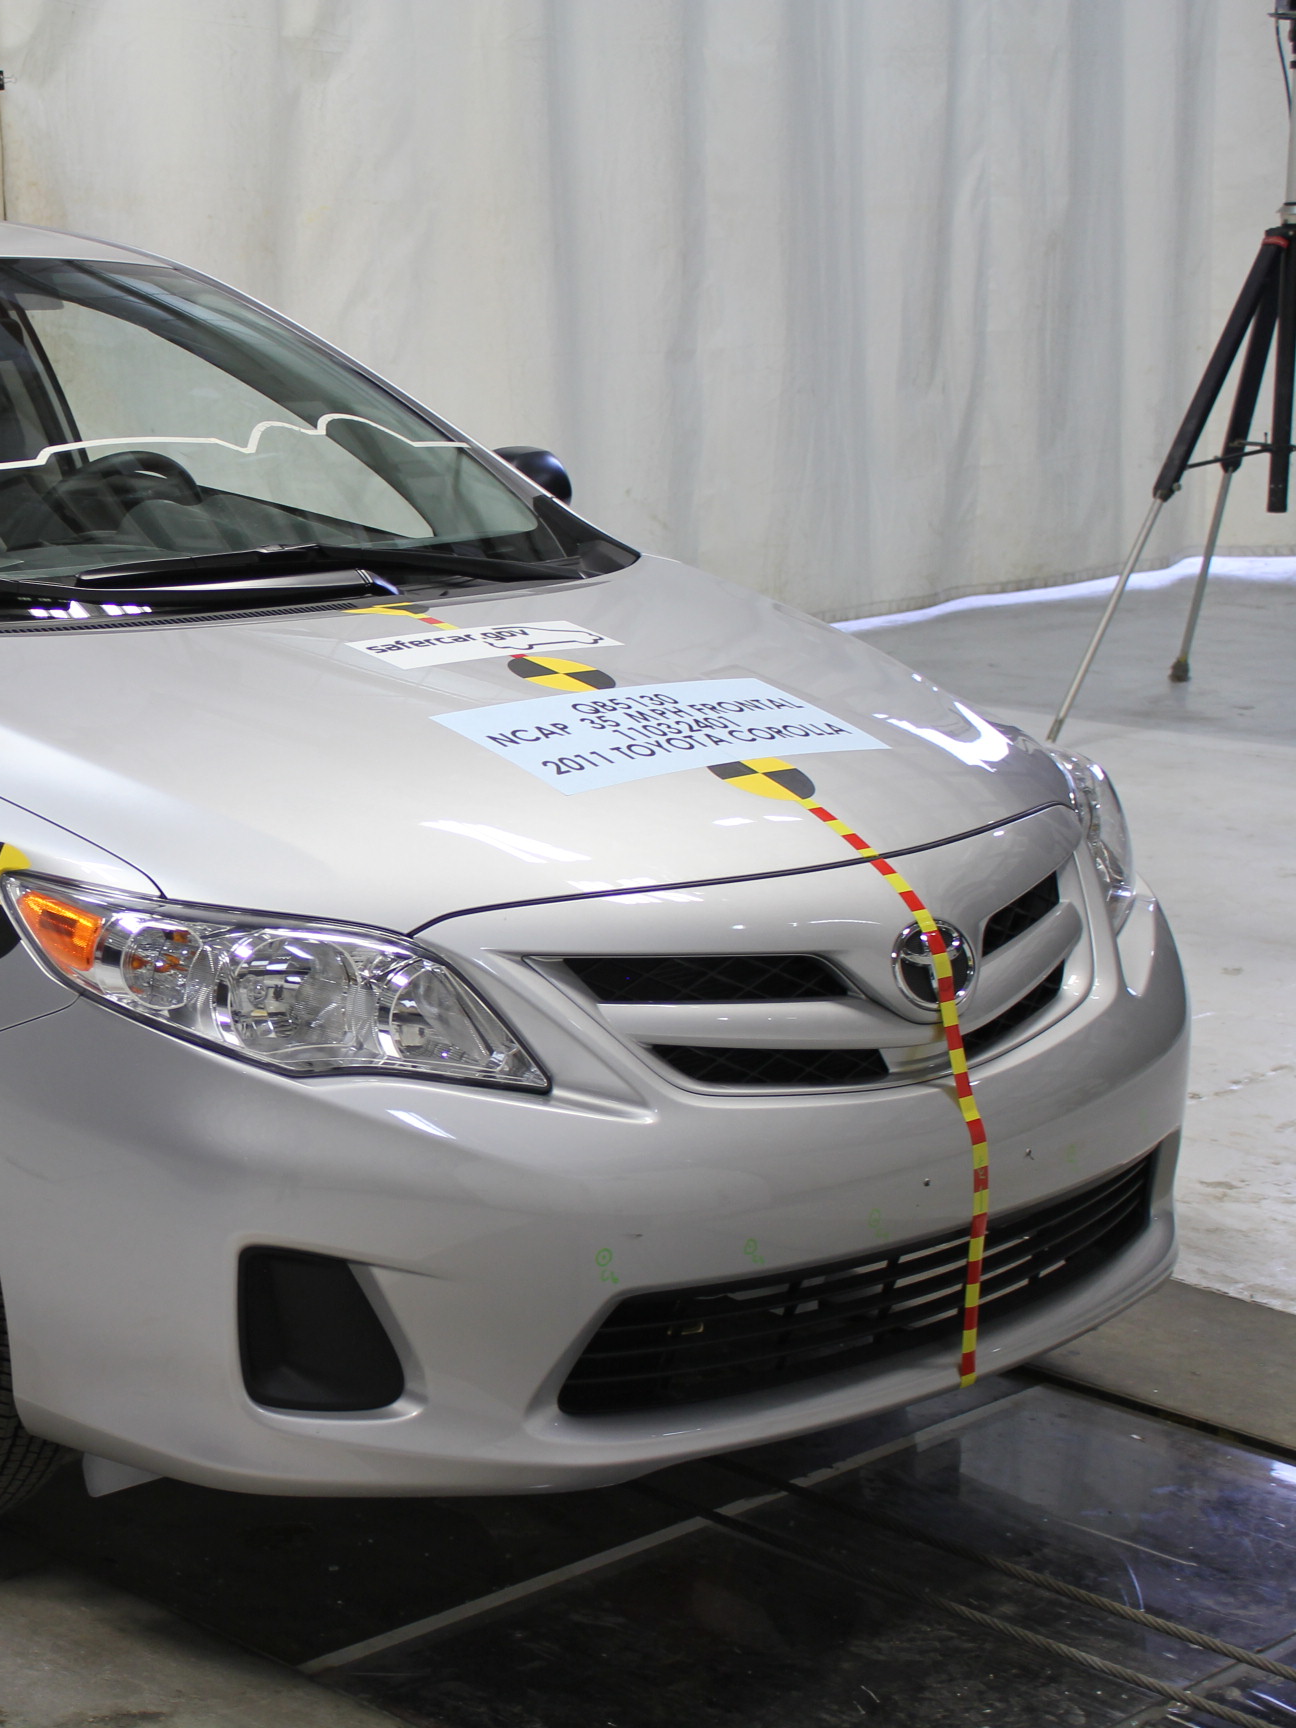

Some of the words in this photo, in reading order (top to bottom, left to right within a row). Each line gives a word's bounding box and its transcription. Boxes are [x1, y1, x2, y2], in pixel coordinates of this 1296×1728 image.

[366, 628, 530, 653] safercar.gov
[571, 693, 679, 715] QB5130
[486, 722, 572, 748] NCAP
[579, 715, 621, 730] 35
[623, 706, 693, 724] MPH
[687, 698, 804, 716] FRONTAL
[612, 716, 741, 741] 11032401
[541, 751, 615, 775] 2011
[609, 733, 733, 760] TOYOTA
[728, 722, 853, 743] COROLLA
